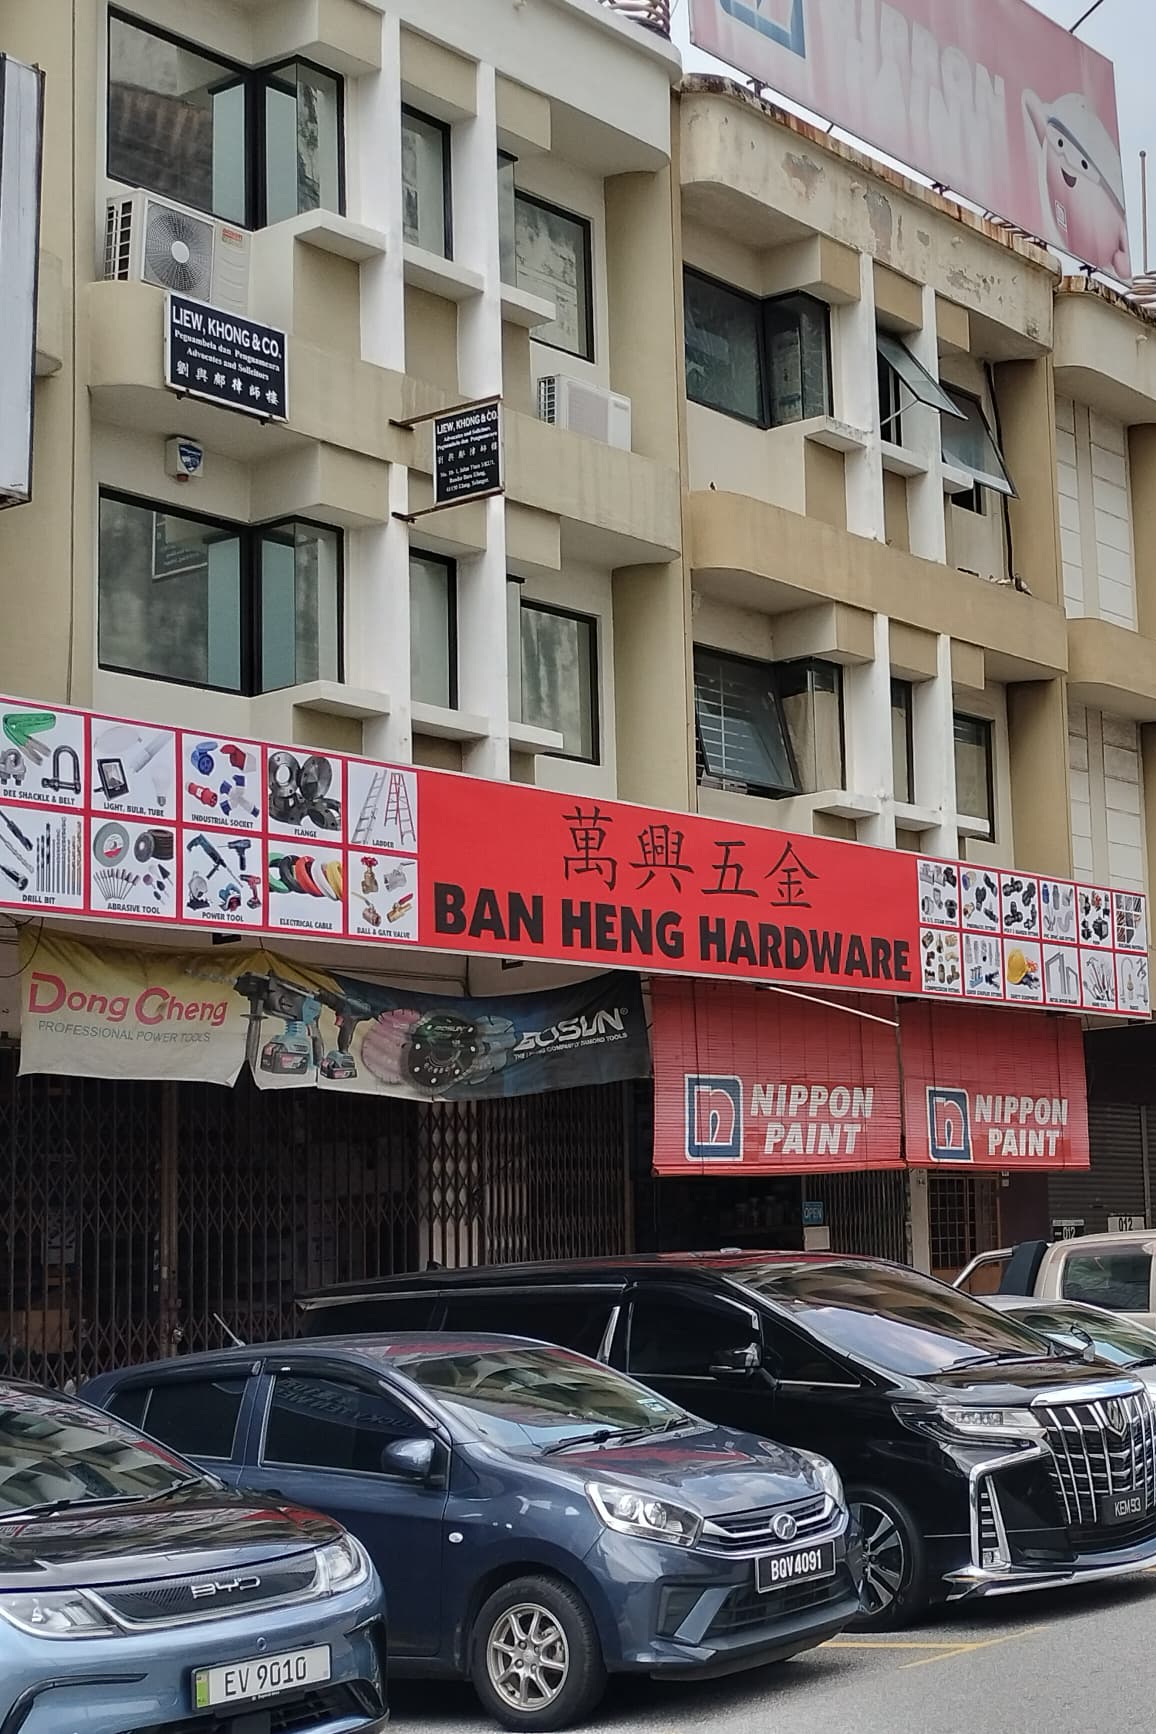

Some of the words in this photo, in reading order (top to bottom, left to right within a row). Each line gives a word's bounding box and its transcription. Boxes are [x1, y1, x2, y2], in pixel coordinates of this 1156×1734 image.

[172, 305, 206, 335] LIEW,
[208, 317, 251, 348] KHONG
[251, 333, 261, 351] &
[261, 337, 282, 359] CO.
[174, 329, 217, 350] Peguambela
[218, 345, 232, 355] dan
[186, 347, 223, 365] Advocates
[223, 360, 237, 370] and
[238, 363, 270, 381] Solicitors
[437, 421, 456, 434] LIEW,
[456, 415, 480, 429] KHONG
[481, 413, 486, 423] &
[487, 410, 499, 421] CO.
[3, 789, 17, 797] DEE
[18, 790, 51, 803] SHACKLE
[51, 795, 57, 803] &
[58, 796, 75, 806] BELT
[104, 802, 126, 813] LIGHT,
[126, 806, 147, 816] BULB,
[148, 808, 165, 817] TUBE
[191, 814, 229, 826] INDUSTRIAL
[230, 818, 254, 829] SOCKET
[294, 828, 317, 838] FLANGE
[372, 839, 394, 848] LADDER
[562, 804, 821, 910] 萬興五金
[22, 894, 43, 904] DRILL
[44, 896, 56, 905] BIT
[107, 902, 141, 913] ABRASIVE
[142, 905, 161, 914] TOOL
[202, 911, 225, 921] POWER
[226, 913, 245, 923] TOOL
[279, 917, 314, 929] ELECTRICAL
[314, 920, 333, 930] CABLE
[356, 926, 372, 935] BALL
[378, 929, 393, 937] GATE
[393, 930, 411, 939] VALVE
[434, 881, 545, 944] BAN
[560, 898, 685, 959] HENG
[699, 915, 912, 982] HARDWARE
[39, 1020, 133, 1042] PROFESSIONAL
[136, 1030, 177, 1044] POWER
[180, 1031, 211, 1043] TOOLS
[606, 1032, 628, 1042] TOOLS
[750, 1083, 874, 1119] NIPPON
[975, 1094, 1069, 1126] NIPPON
[764, 1122, 862, 1155] PAINT
[988, 1128, 1060, 1157] PAINT
[803, 1207, 822, 1220] OPEN
[1119, 1217, 1133, 1232] 012
[770, 1549, 823, 1582] BQV4091
[191, 1575, 261, 1600] BYD
[224, 1668, 250, 1697] EV
[256, 1655, 307, 1691] 9010
